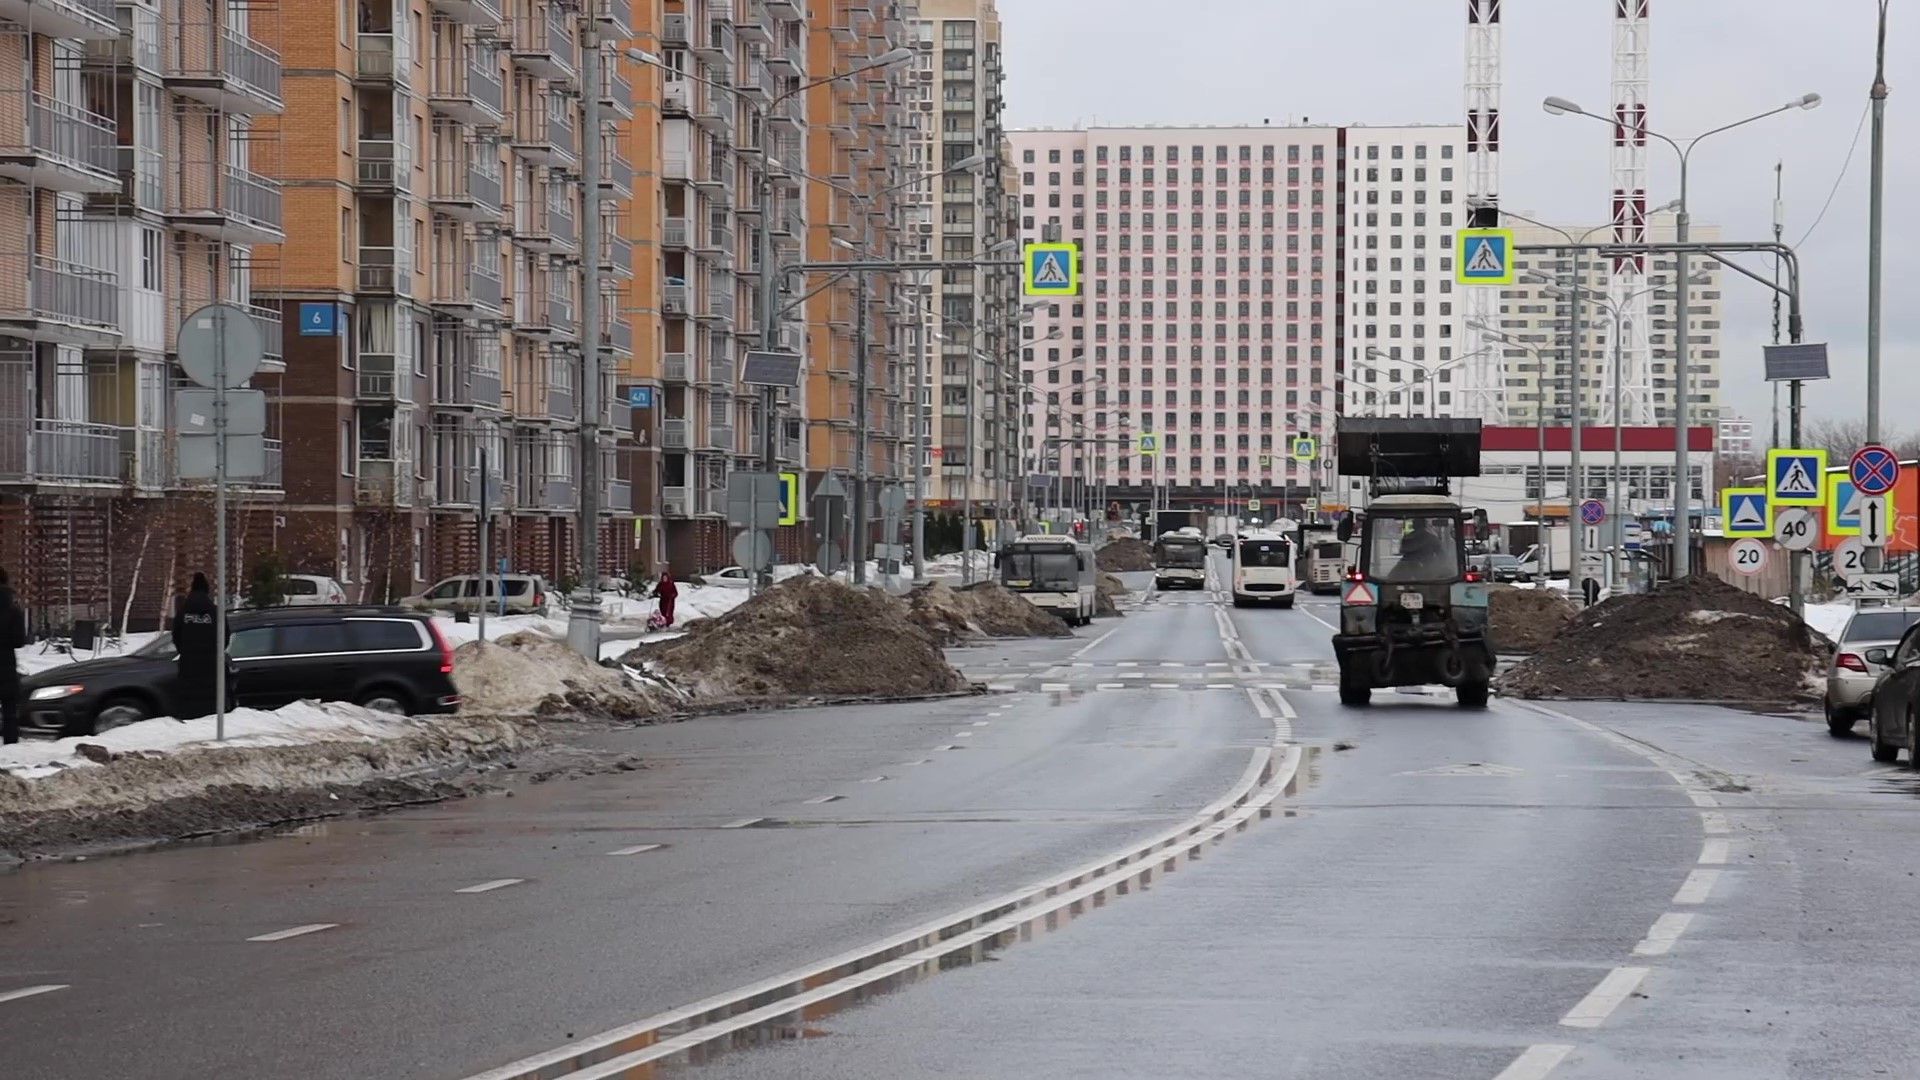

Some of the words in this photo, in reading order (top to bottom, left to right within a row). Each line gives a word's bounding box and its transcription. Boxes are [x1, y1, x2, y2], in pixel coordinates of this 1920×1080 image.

[313, 312, 321, 324] 6
[1783, 521, 1806, 537] 40
[1737, 549, 1760, 564] 20
